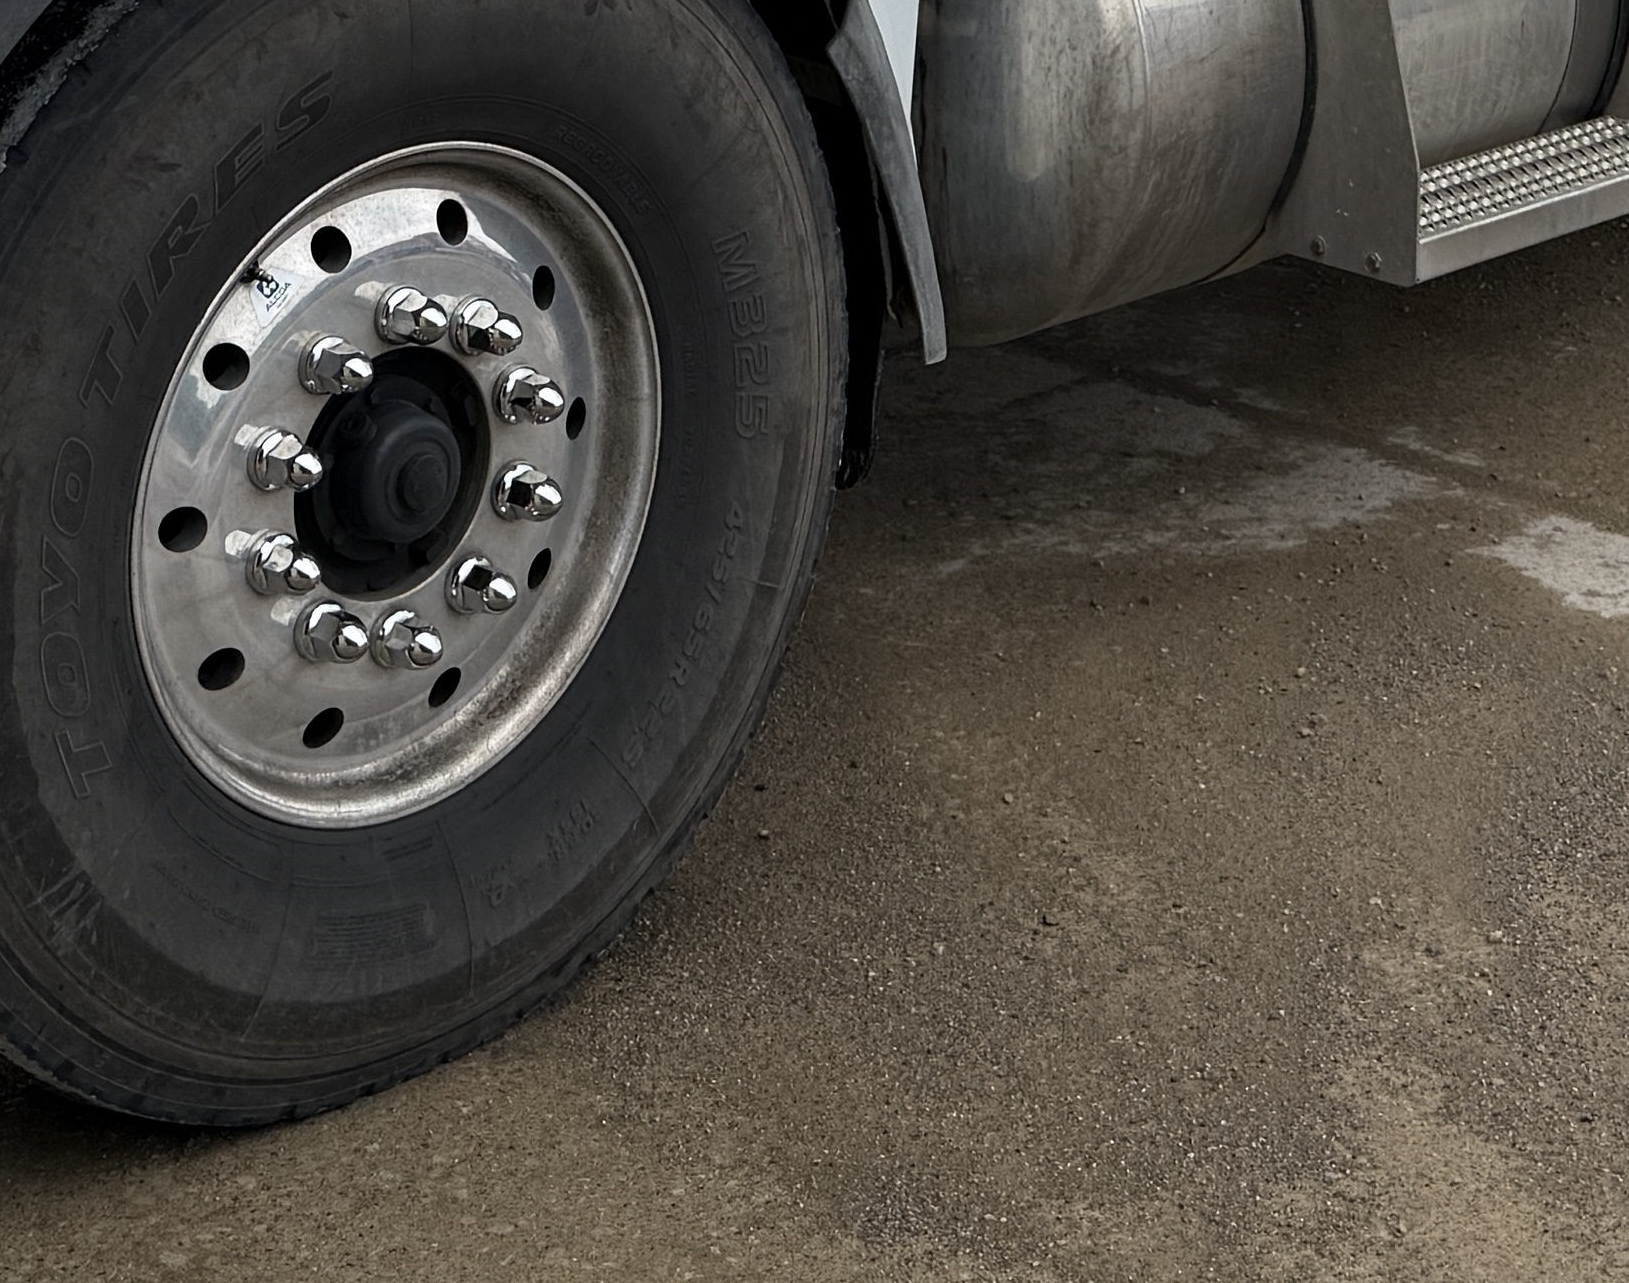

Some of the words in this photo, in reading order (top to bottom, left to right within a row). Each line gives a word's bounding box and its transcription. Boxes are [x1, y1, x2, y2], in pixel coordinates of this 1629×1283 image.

[39, 435, 114, 799] TOYO
[78, 69, 336, 411] TIRES
[713, 229, 771, 440] M325
